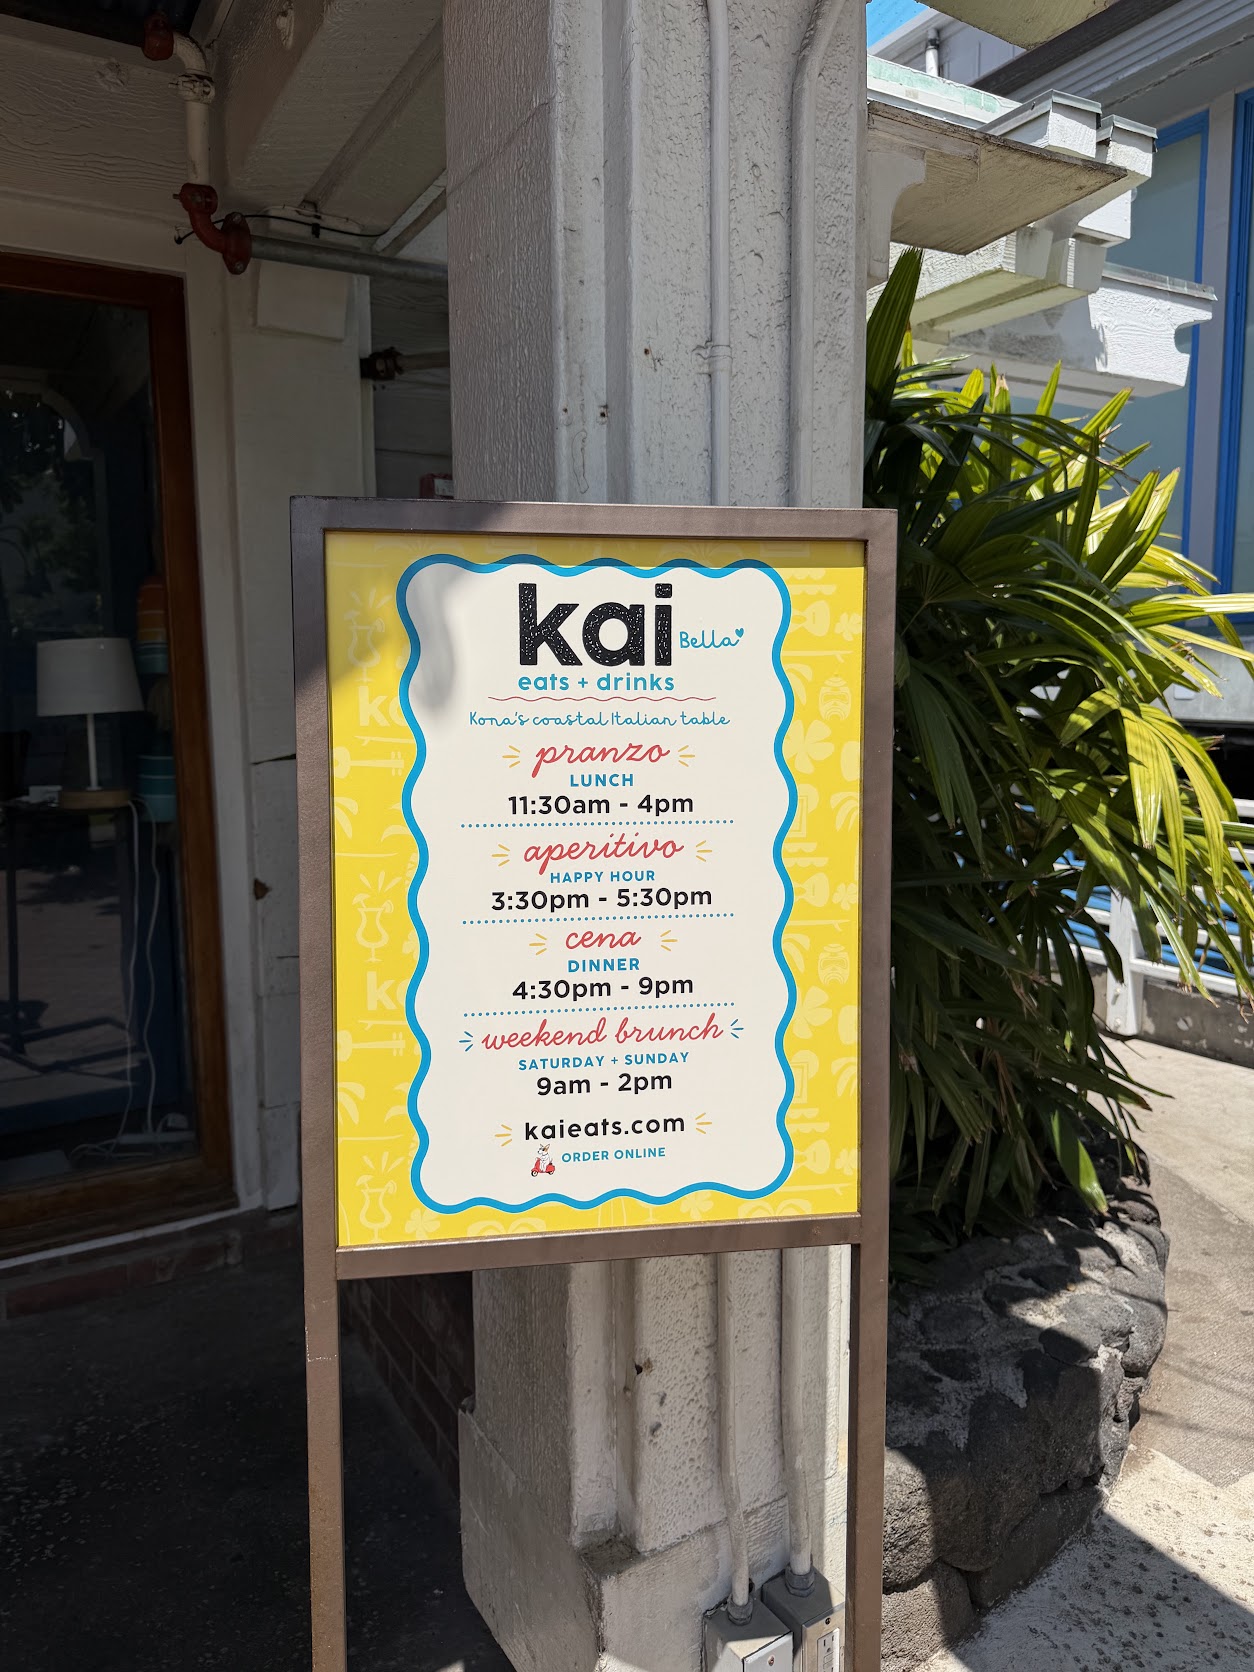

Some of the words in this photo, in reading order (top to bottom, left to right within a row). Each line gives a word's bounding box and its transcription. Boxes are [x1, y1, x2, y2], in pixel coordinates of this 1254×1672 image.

[518, 582, 673, 668] kai
[679, 629, 739, 649] Bella
[517, 673, 570, 691] eats
[577, 677, 589, 689] +
[596, 671, 675, 692] drinks
[469, 711, 530, 727] Kona's
[532, 711, 610, 727] coastal
[611, 711, 678, 727] Italian
[679, 710, 731, 726] table
[531, 742, 671, 779] pranzo
[569, 773, 634, 788] LUNCH
[507, 795, 610, 815] 11:30am
[637, 794, 694, 817] 4pm
[523, 831, 685, 876] aperitivo
[550, 871, 604, 884] HAPPY
[609, 869, 655, 883] HOUR
[491, 890, 590, 914] 3:30pm
[616, 887, 712, 910] 5:30pm
[565, 930, 642, 950] cena
[567, 957, 640, 973] DINNER
[511, 979, 612, 1002] 4:30pm
[638, 976, 694, 999] 9pm
[480, 1016, 608, 1051] weekend
[614, 1012, 724, 1045] brunch
[518, 1055, 605, 1071] SATURDAY
[610, 1056, 619, 1065] +
[624, 1051, 690, 1066] SUNDAY
[536, 1076, 591, 1096] 9am
[617, 1072, 672, 1095] 2pm
[524, 1117, 685, 1141] kaieats.com
[561, 1150, 609, 1163] ORDER
[613, 1146, 666, 1160] ONLINE
